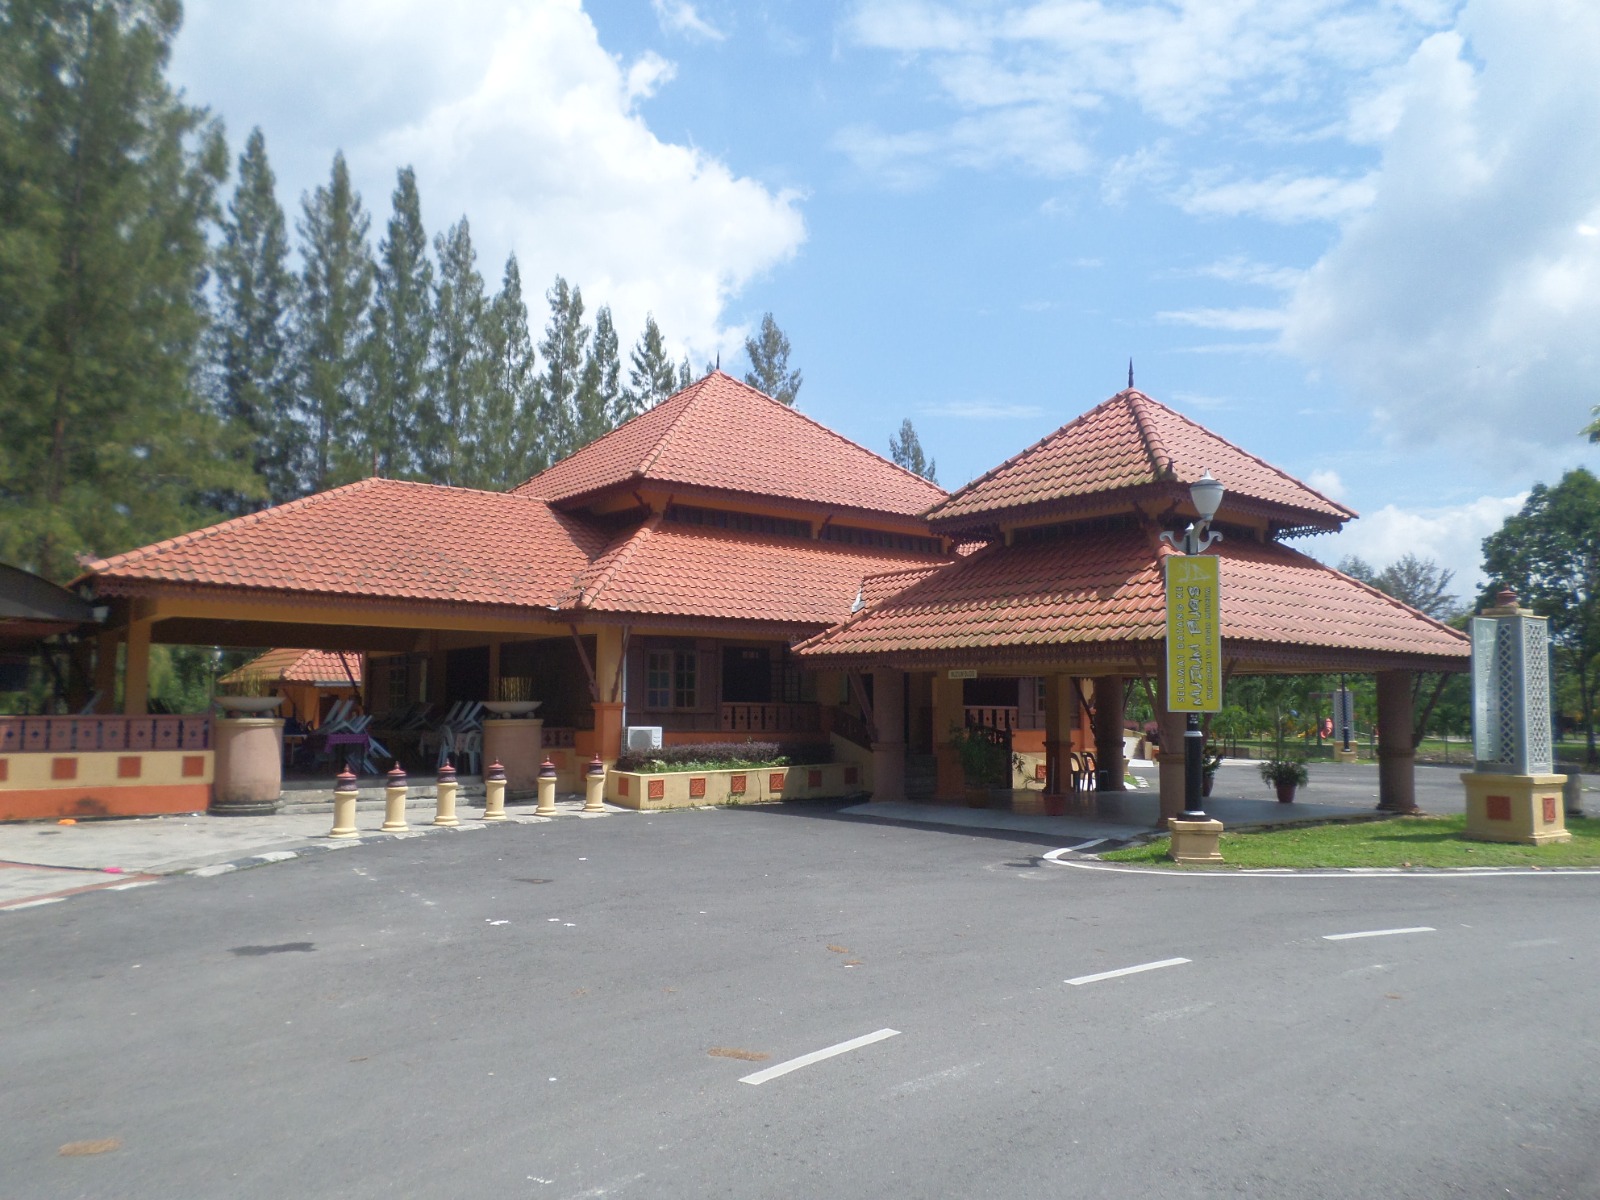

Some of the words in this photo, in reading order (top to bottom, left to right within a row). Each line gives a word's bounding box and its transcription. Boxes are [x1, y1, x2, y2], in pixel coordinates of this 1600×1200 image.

[1176, 586, 1184, 599] KE
[1176, 604, 1185, 649] DATANG
[1177, 655, 1185, 702] SELAMAT
